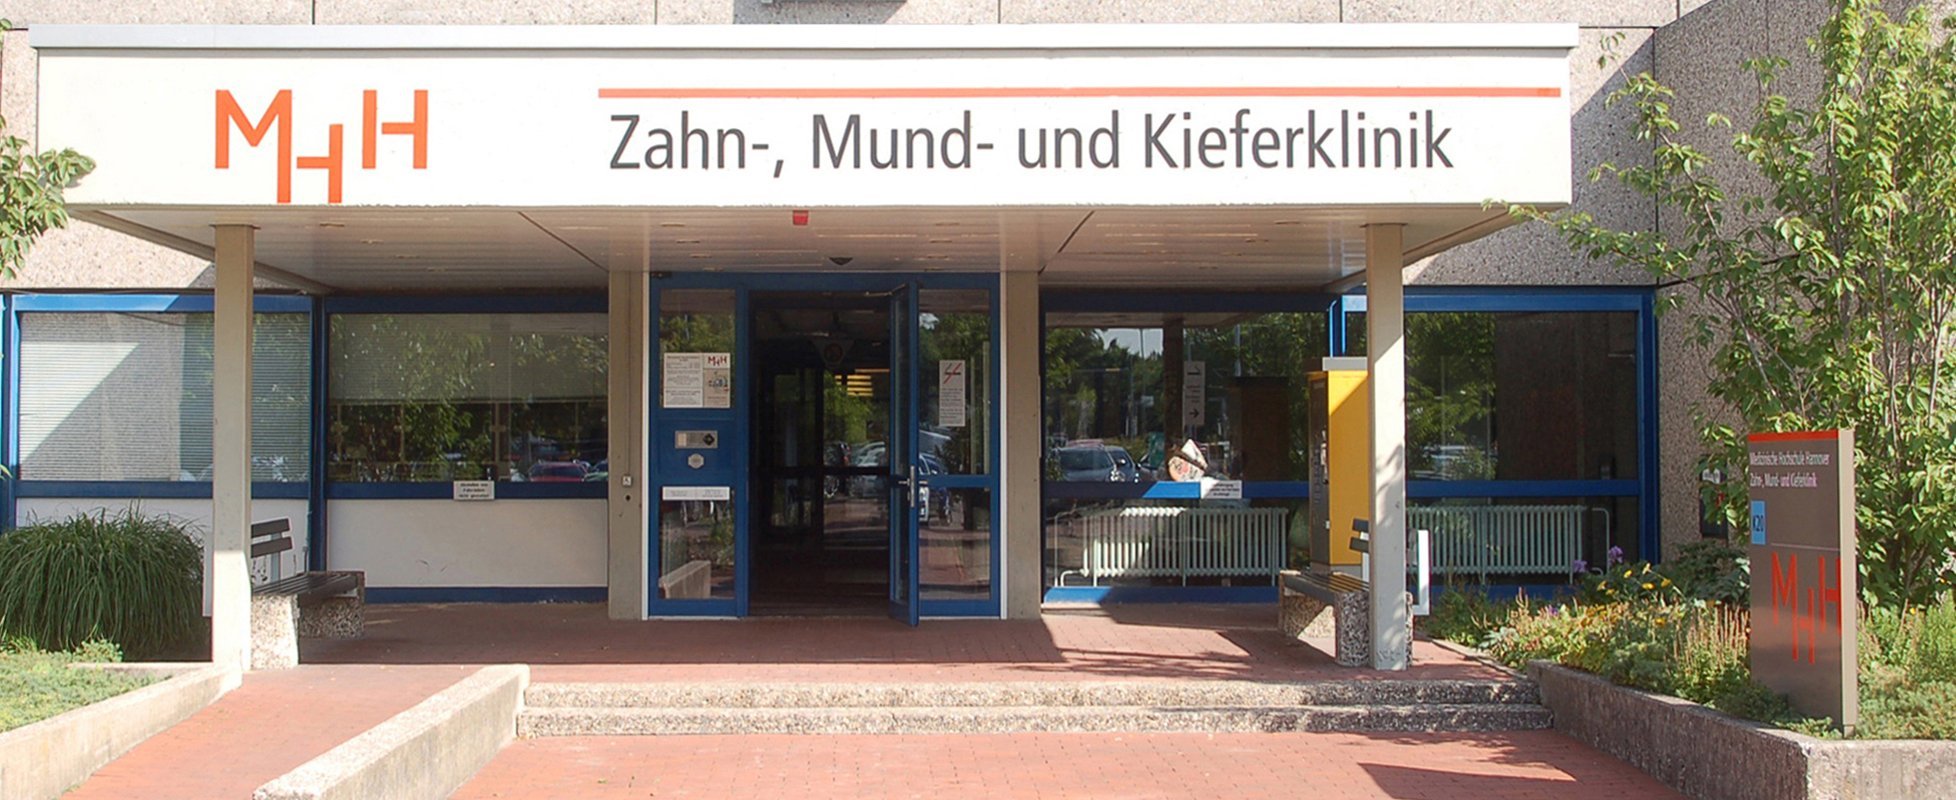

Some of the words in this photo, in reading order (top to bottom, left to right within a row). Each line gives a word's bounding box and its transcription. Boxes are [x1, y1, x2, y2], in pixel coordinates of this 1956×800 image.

[215, 89, 428, 203] MHH
[610, 110, 783, 178] Zahn-,
[813, 110, 994, 169] Mund-
[1018, 109, 1119, 169] und
[1145, 108, 1453, 169] Kieferklinik
[707, 355, 728, 367] MHH
[1771, 551, 1843, 665] MHH
